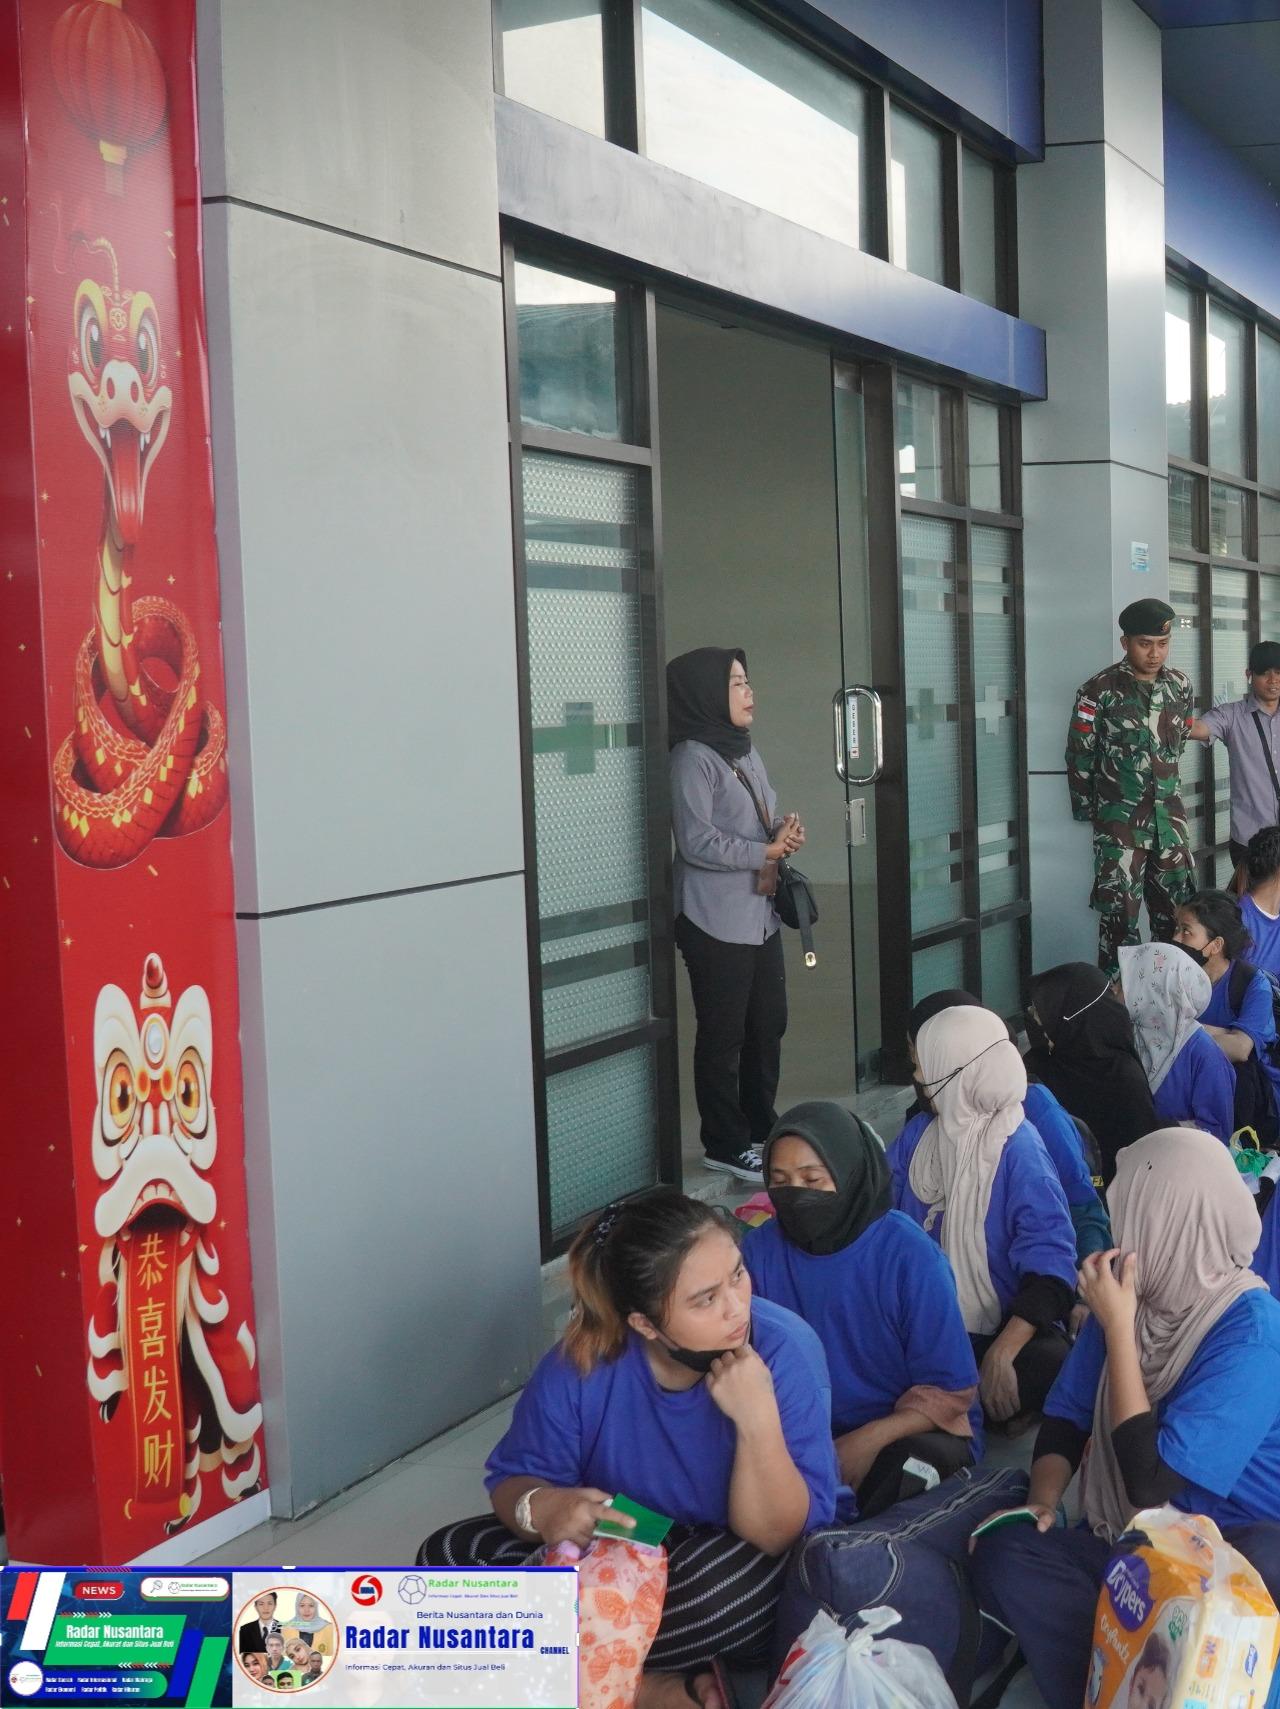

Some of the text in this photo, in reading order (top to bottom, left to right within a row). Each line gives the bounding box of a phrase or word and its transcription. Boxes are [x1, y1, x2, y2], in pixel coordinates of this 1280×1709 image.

[137, 1232, 175, 1488] 恭喜发财
[1106, 1560, 1146, 1622] Drypers
